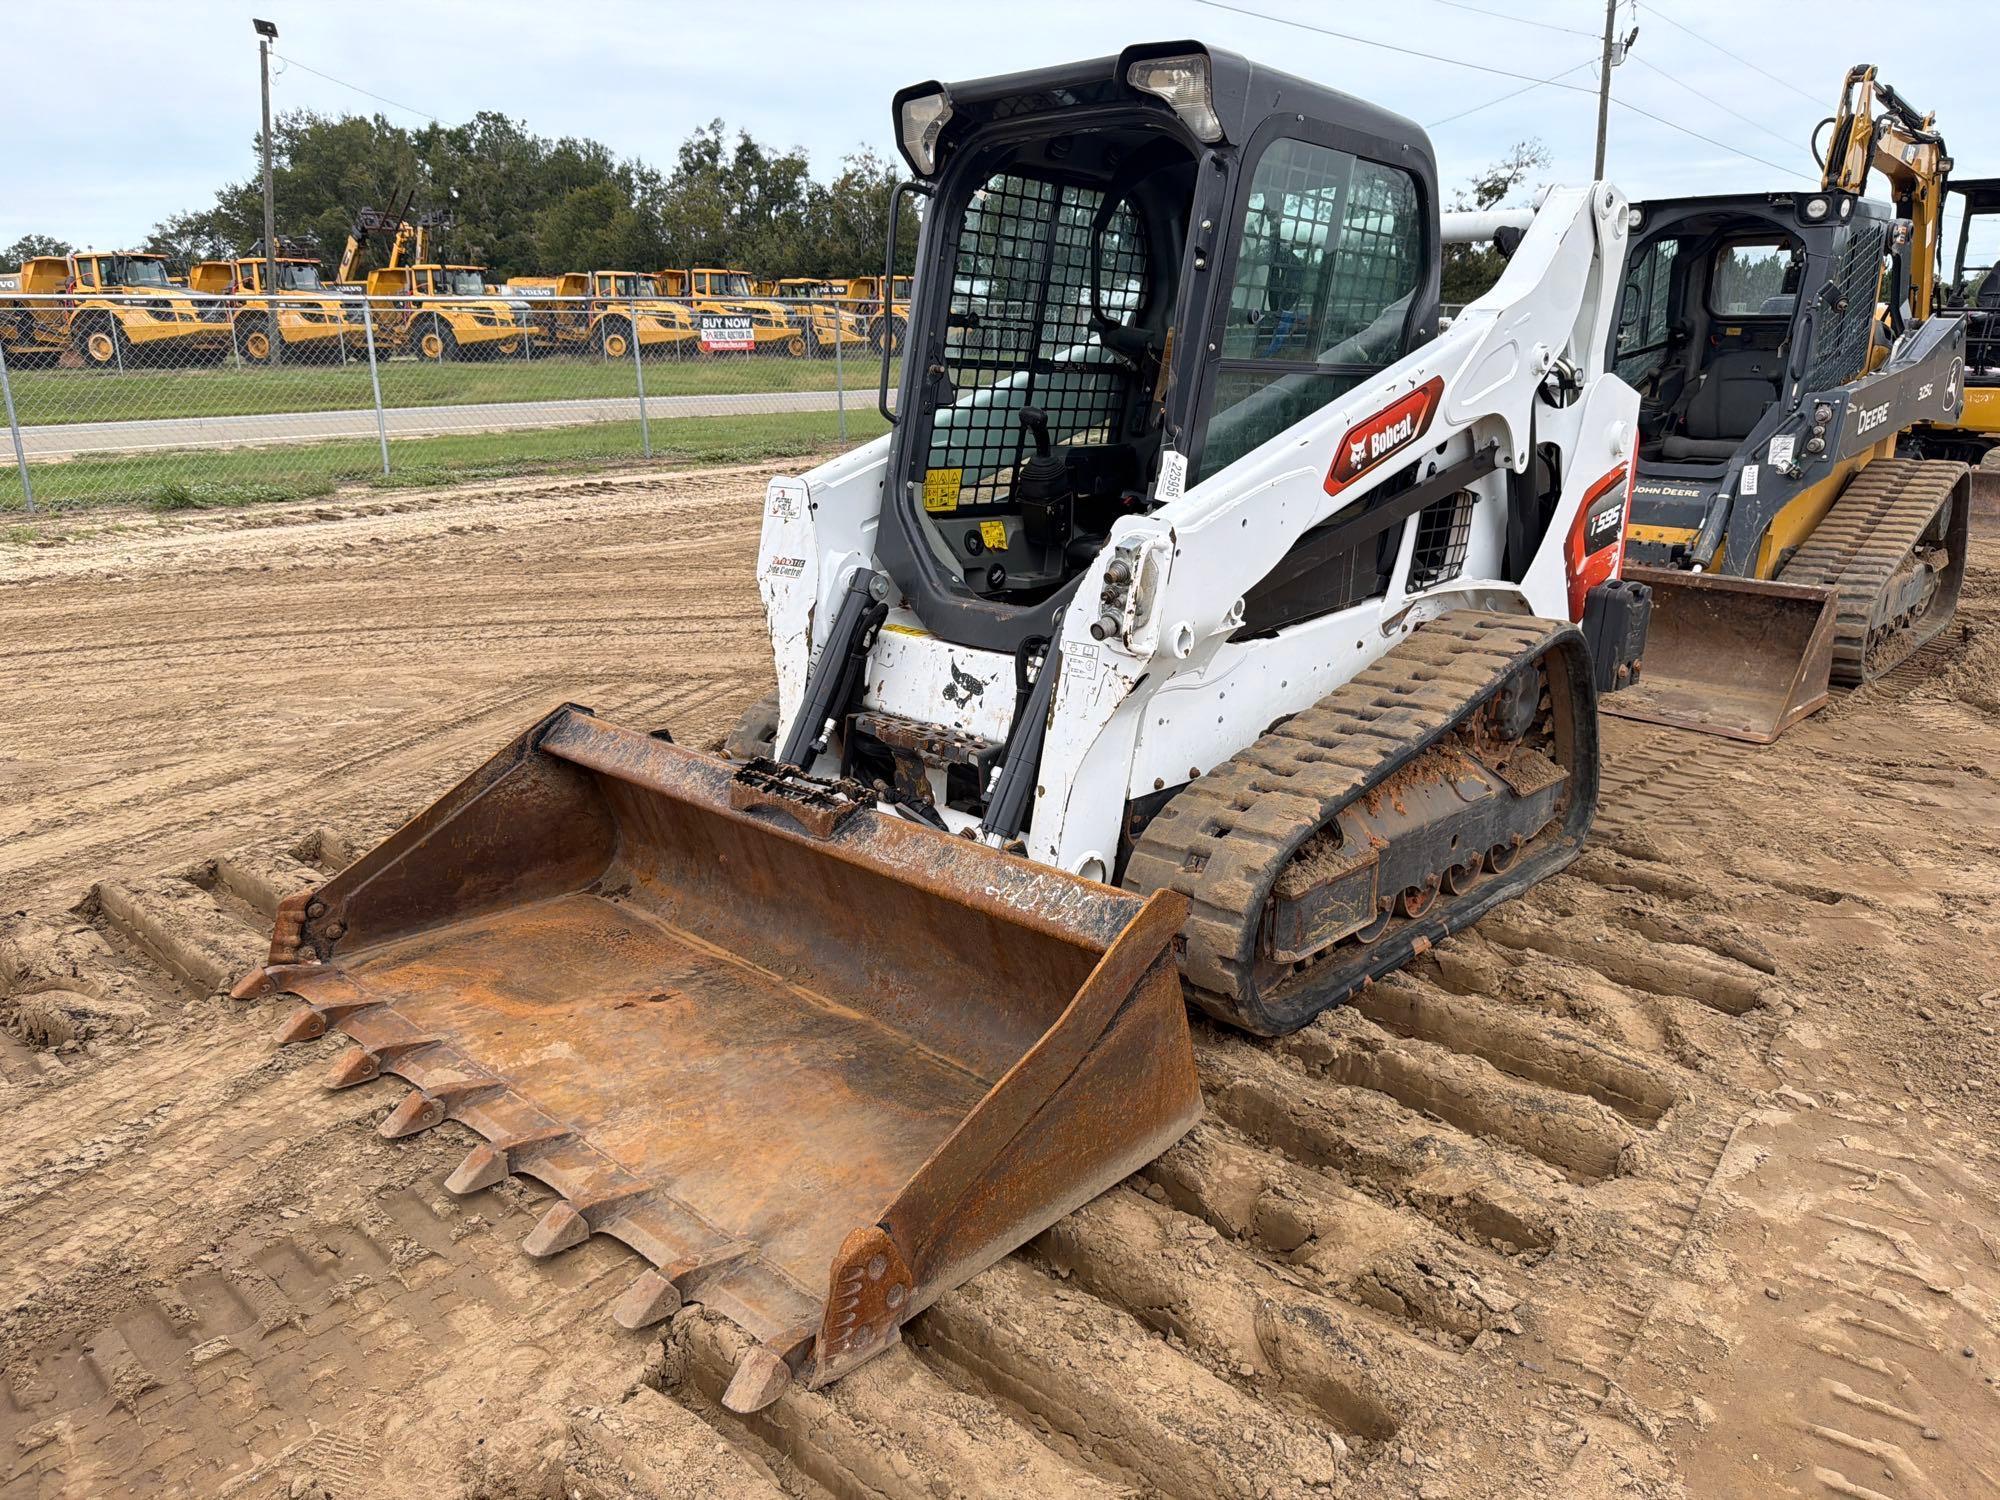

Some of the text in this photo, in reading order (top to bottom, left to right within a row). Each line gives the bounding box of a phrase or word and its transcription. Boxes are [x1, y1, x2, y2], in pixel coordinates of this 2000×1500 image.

[519, 288, 551, 296] VOLVO
[702, 317, 751, 328] BUY NOW
[1917, 382, 1934, 401] 325G
[1857, 402, 1890, 436] DEERE
[1370, 412, 1413, 459] Bobcat
[1165, 461, 1183, 498] 225956
[1632, 485, 1700, 498] JOHN DEERE
[1590, 503, 1622, 537] T595
